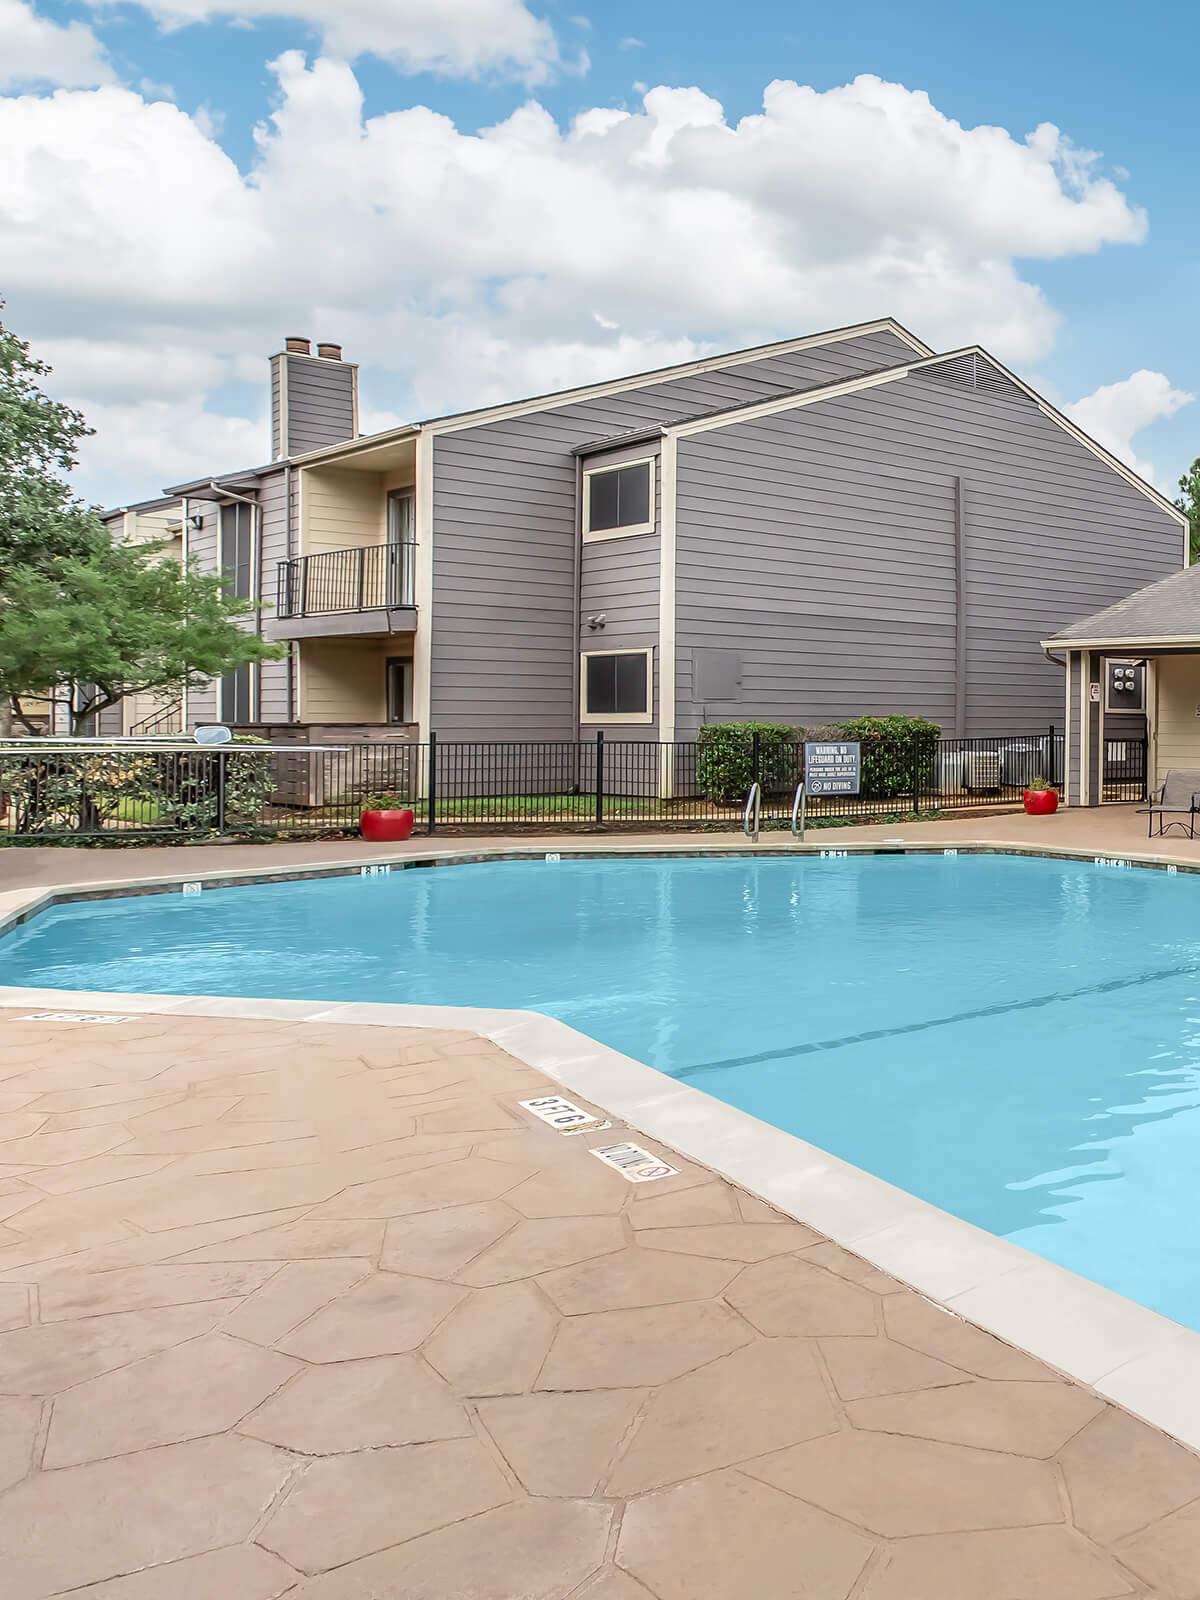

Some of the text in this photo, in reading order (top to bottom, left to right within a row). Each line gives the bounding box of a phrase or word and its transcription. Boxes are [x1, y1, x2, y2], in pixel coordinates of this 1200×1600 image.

[809, 755, 834, 764] LIFEGUARD
[835, 755, 842, 763] ON
[823, 782, 851, 790] NO DIVING
[529, 1099, 585, 1124] 3 FT 6
